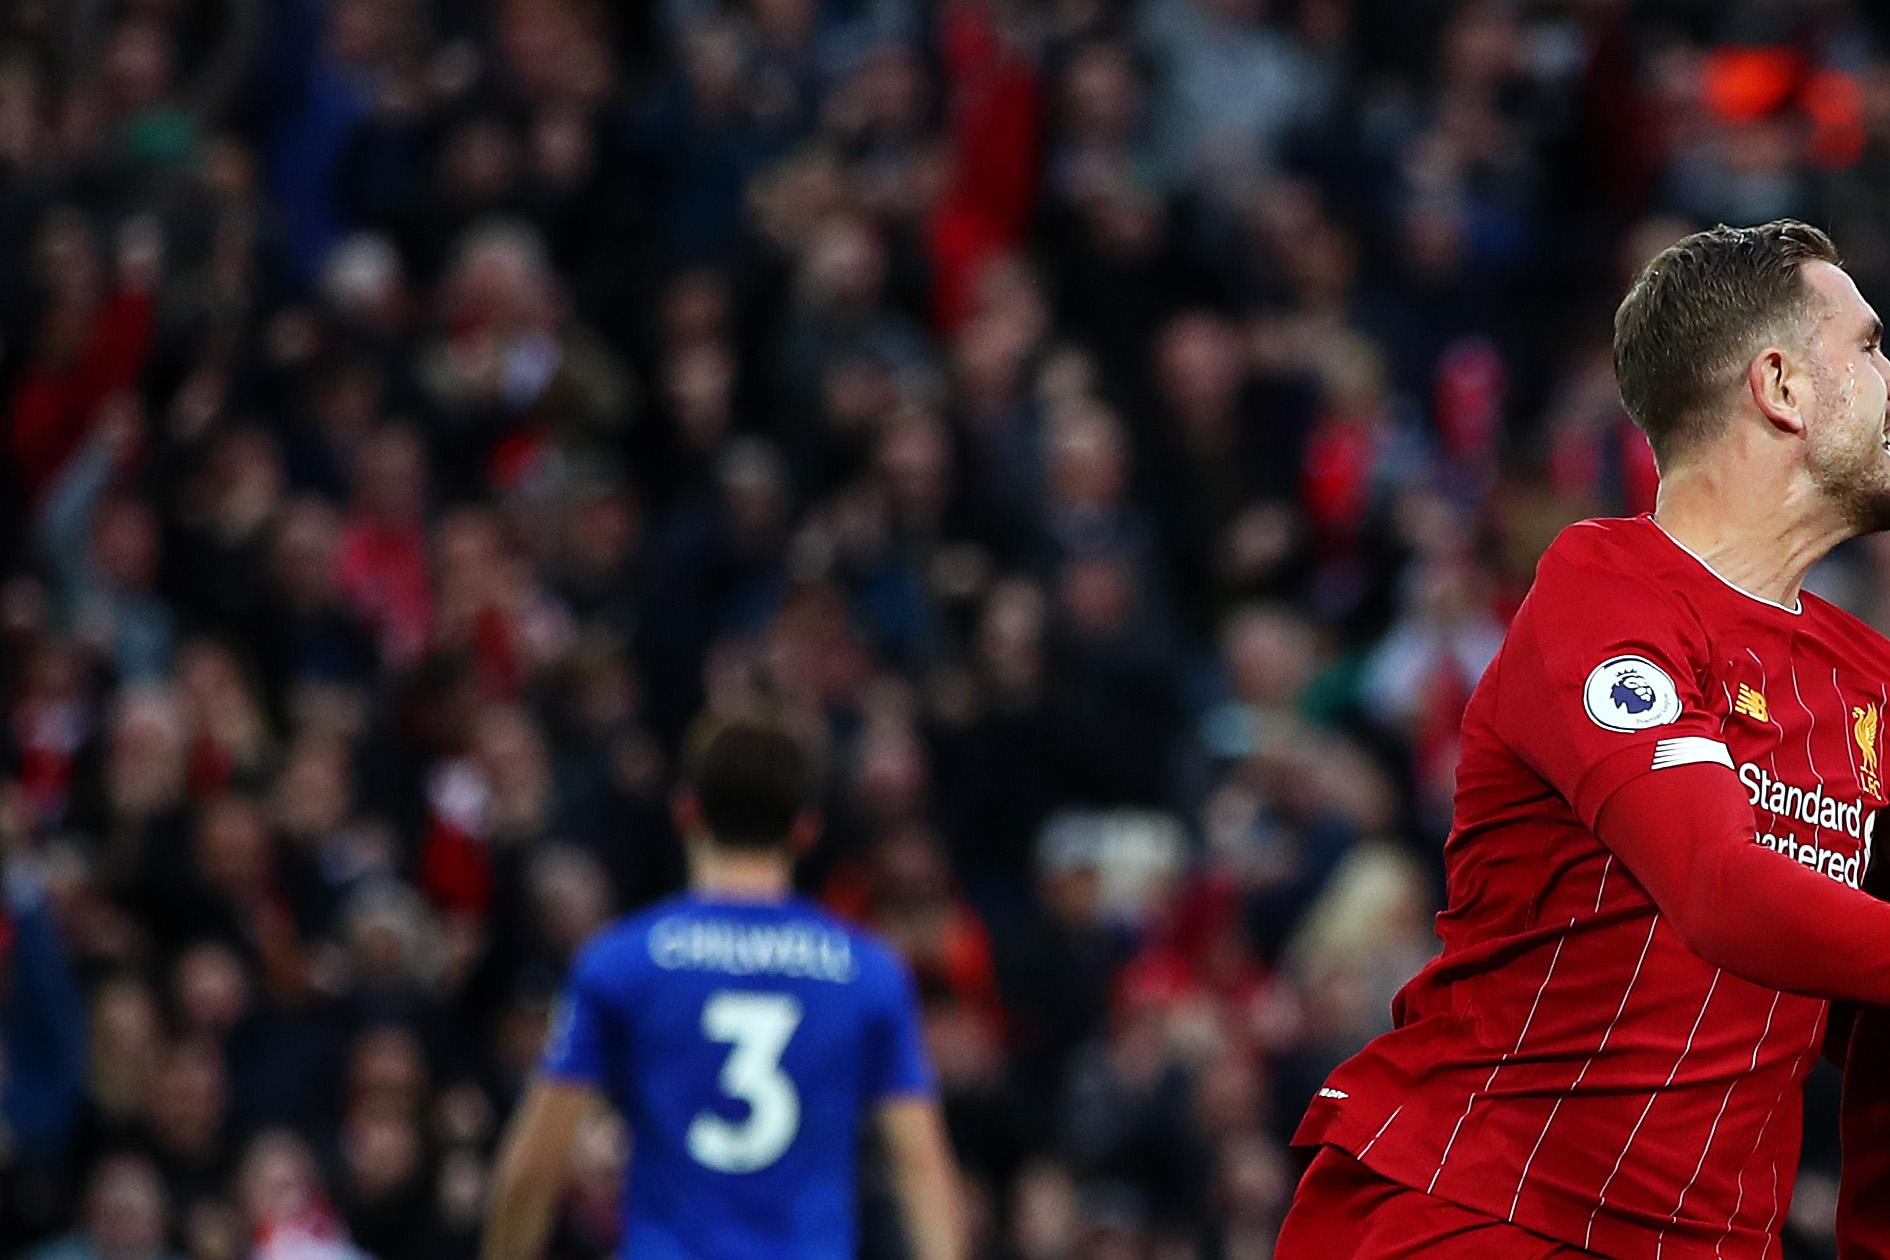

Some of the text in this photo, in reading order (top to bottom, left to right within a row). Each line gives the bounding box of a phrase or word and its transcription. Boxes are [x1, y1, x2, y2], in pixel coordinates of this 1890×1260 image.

[1739, 762, 1861, 838] Standard
[1755, 828, 1860, 890] artered
[685, 990, 803, 1175] 3
